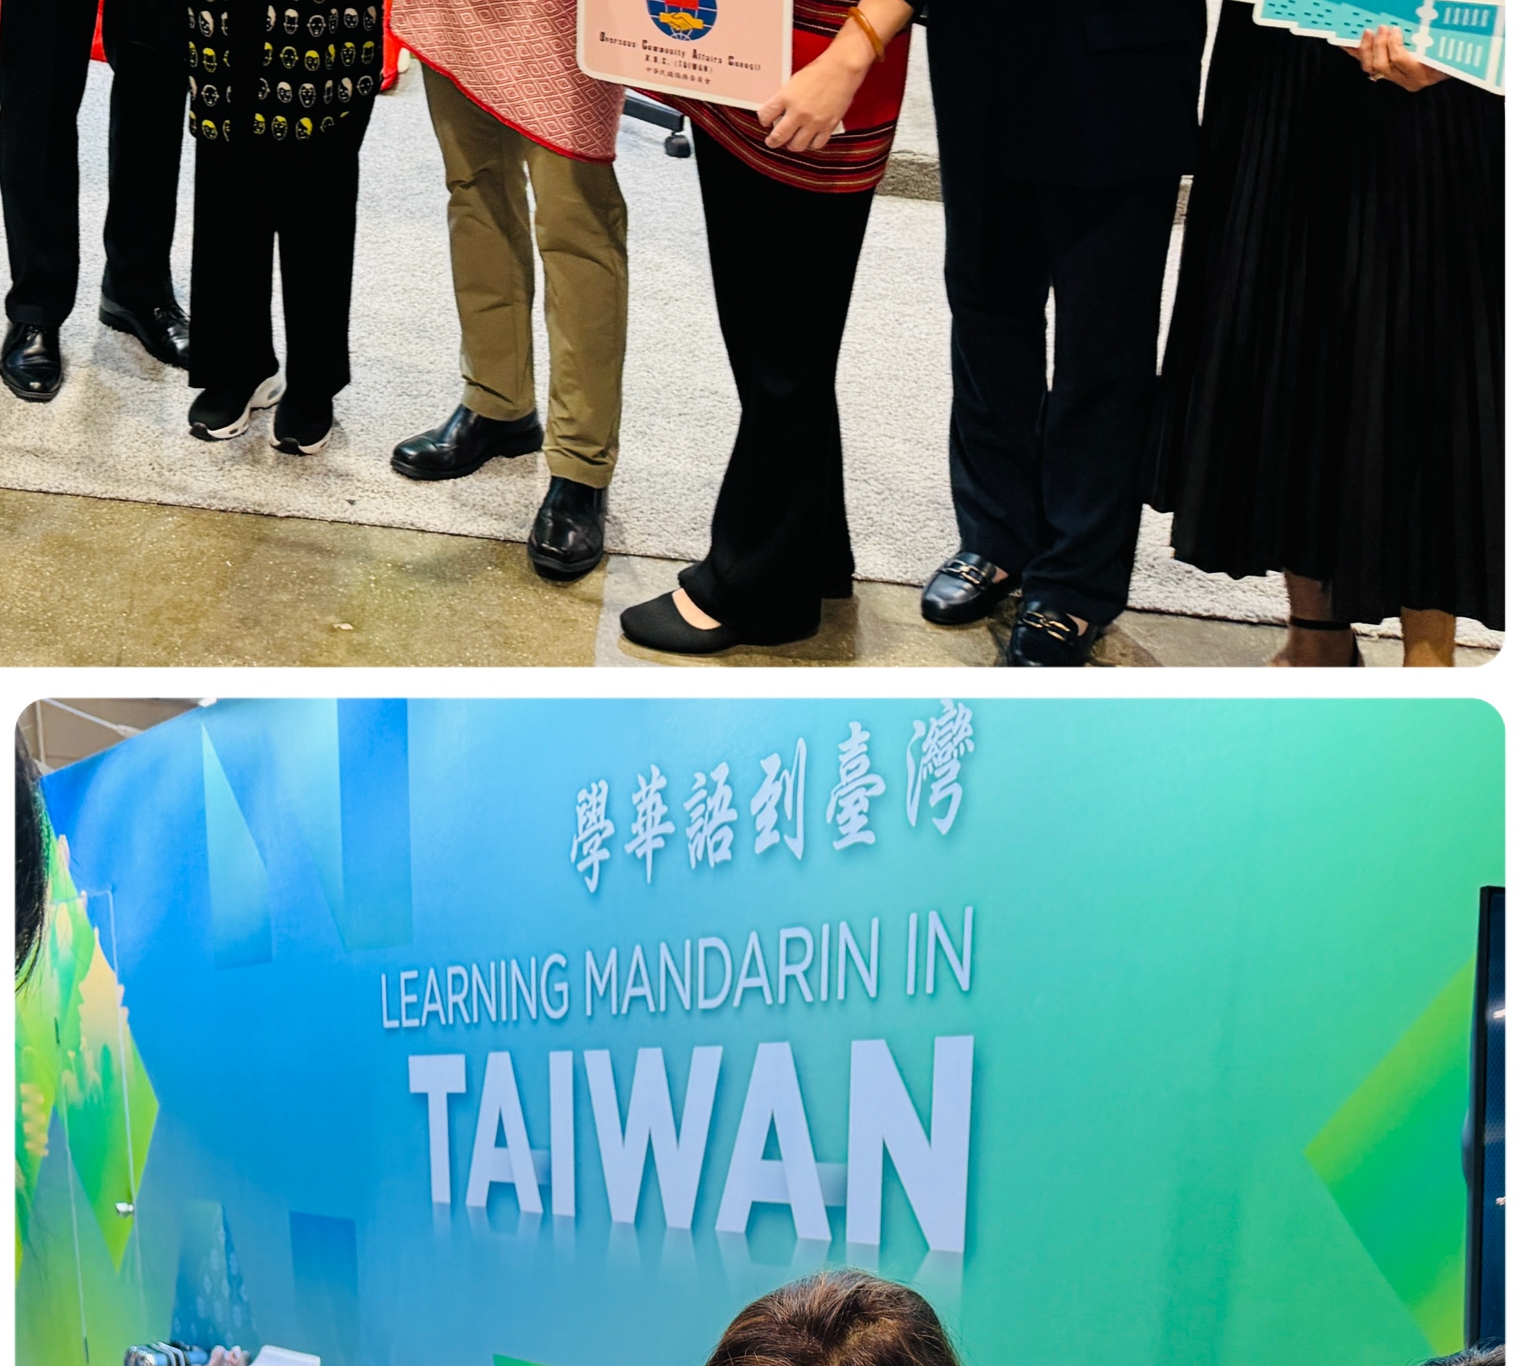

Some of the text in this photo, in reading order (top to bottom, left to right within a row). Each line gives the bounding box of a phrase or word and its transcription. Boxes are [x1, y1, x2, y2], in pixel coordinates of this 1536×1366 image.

[569, 698, 976, 894] 學華語到臺灣
[380, 906, 975, 1030] LEARNING MANDARIN IN
[408, 1034, 976, 1254] TAIWAN
